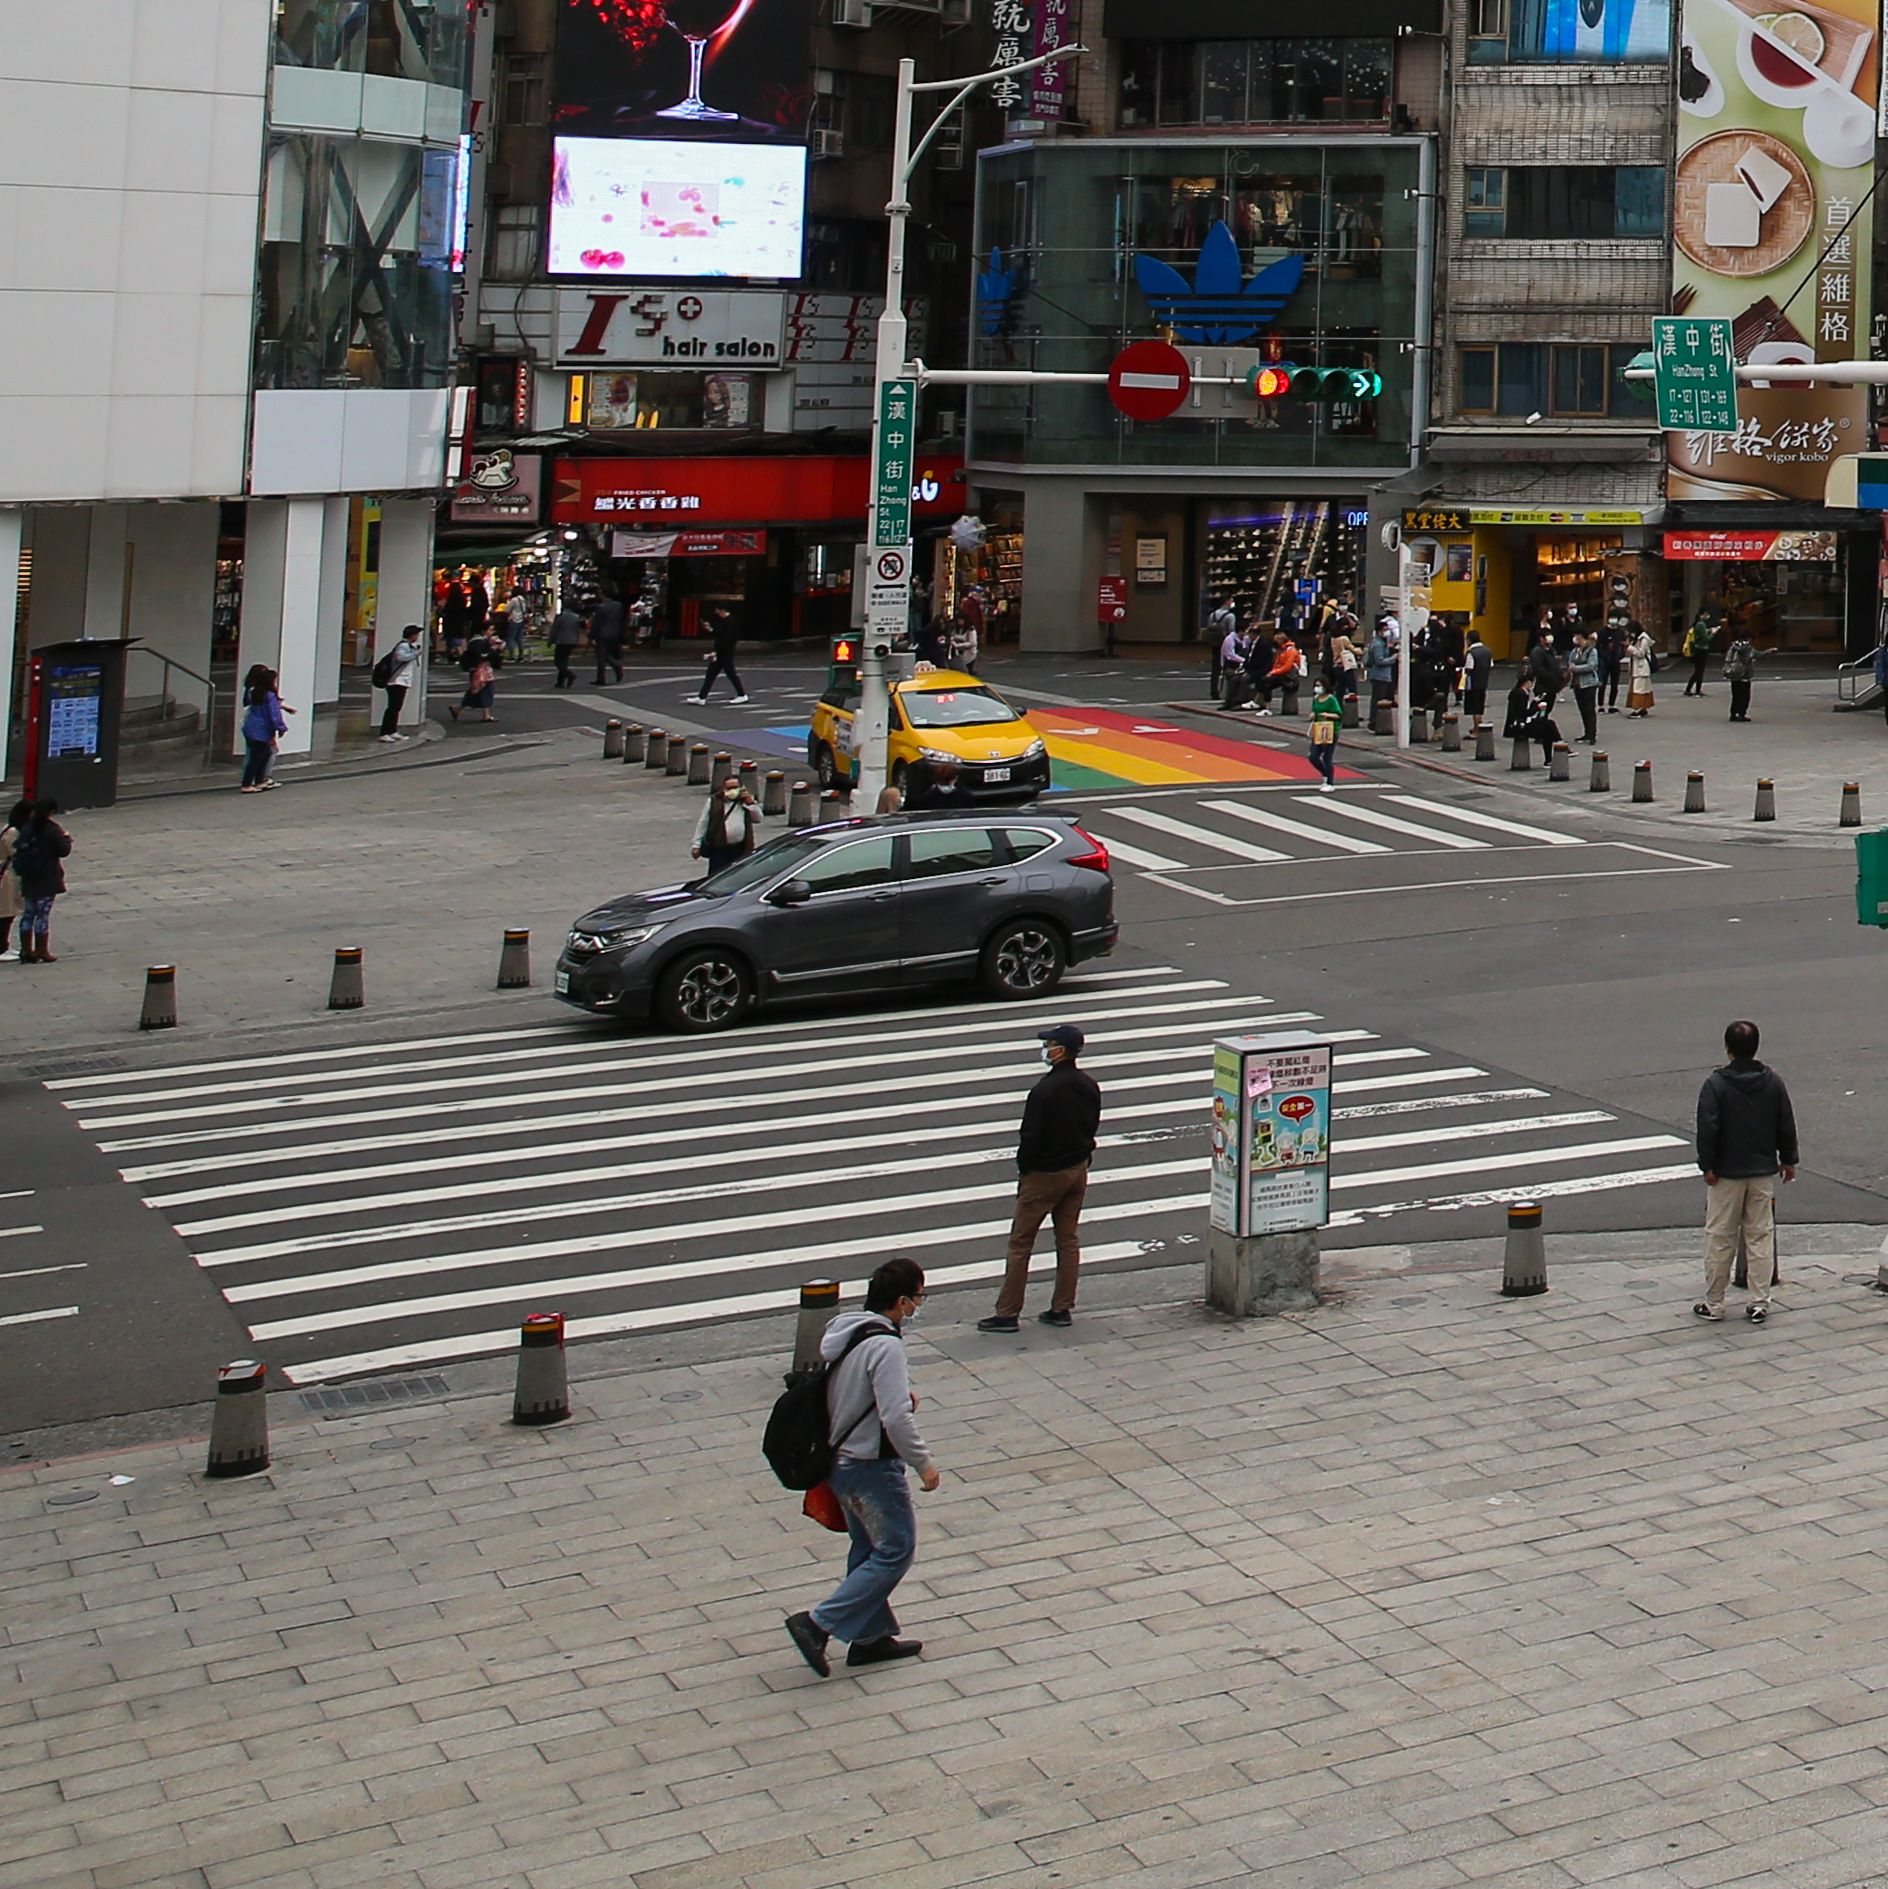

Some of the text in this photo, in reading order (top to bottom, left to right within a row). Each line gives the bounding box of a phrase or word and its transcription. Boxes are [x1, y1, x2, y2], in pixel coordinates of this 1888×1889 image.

[1819, 195, 1854, 343] 首選維格
[662, 336, 775, 357] hair salon
[1660, 324, 1726, 356] 漢中街
[1672, 364, 1718, 380] HanZhong St
[1668, 389, 1692, 403] 17-127
[1669, 409, 1694, 424] 22-116
[885, 400, 907, 480] 漢中街
[1684, 416, 1839, 466] 維格餅家
[1765, 450, 1829, 464] vigor kobo
[880, 484, 898, 493] Han
[880, 496, 907, 506] Zhong
[879, 508, 890, 517] St
[880, 520, 905, 529] 22 17
